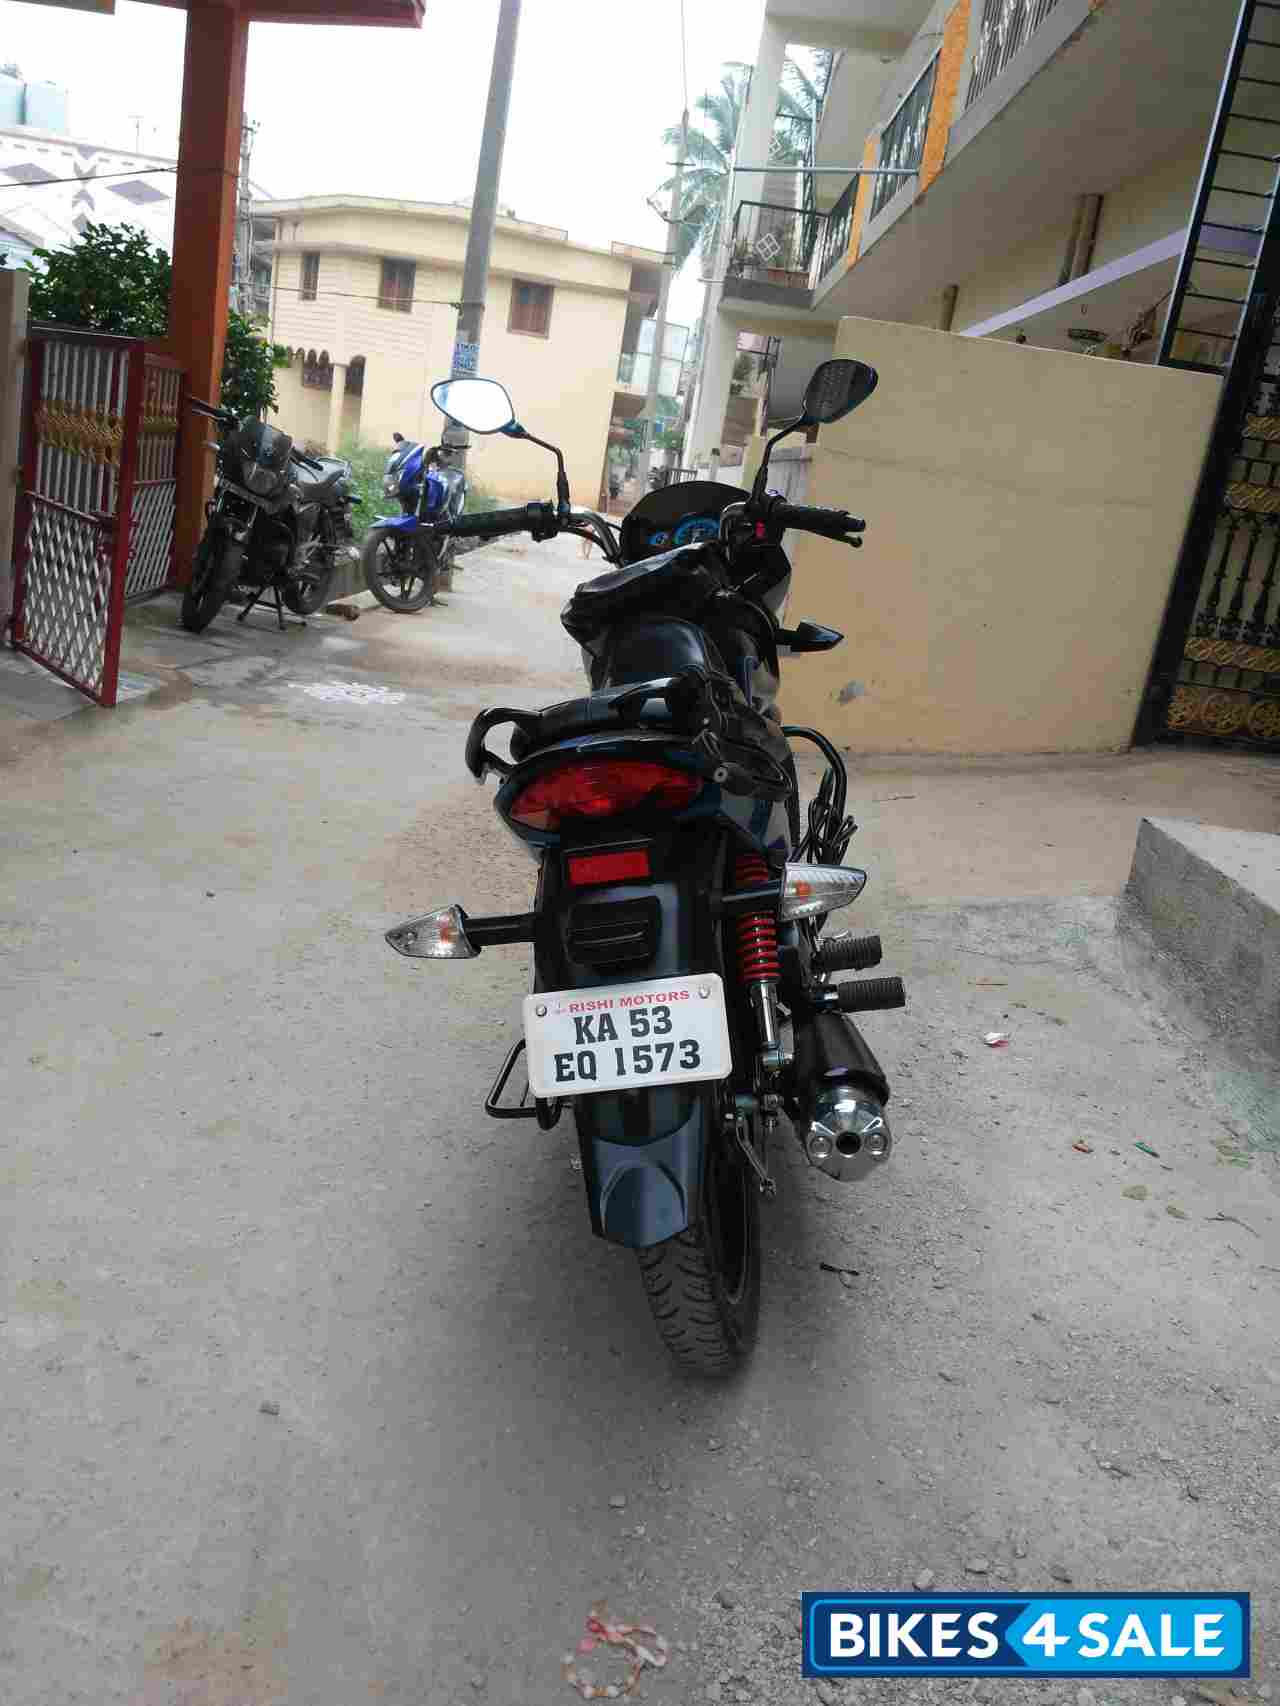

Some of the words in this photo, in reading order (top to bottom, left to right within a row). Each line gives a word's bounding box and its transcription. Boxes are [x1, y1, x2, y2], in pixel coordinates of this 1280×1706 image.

[569, 999, 613, 1013] RISHI
[619, 990, 690, 1008] MOTORS
[574, 1012, 618, 1045] KA
[629, 1006, 673, 1037] 53
[554, 1050, 597, 1082] EQ
[615, 1039, 701, 1076] 1573
